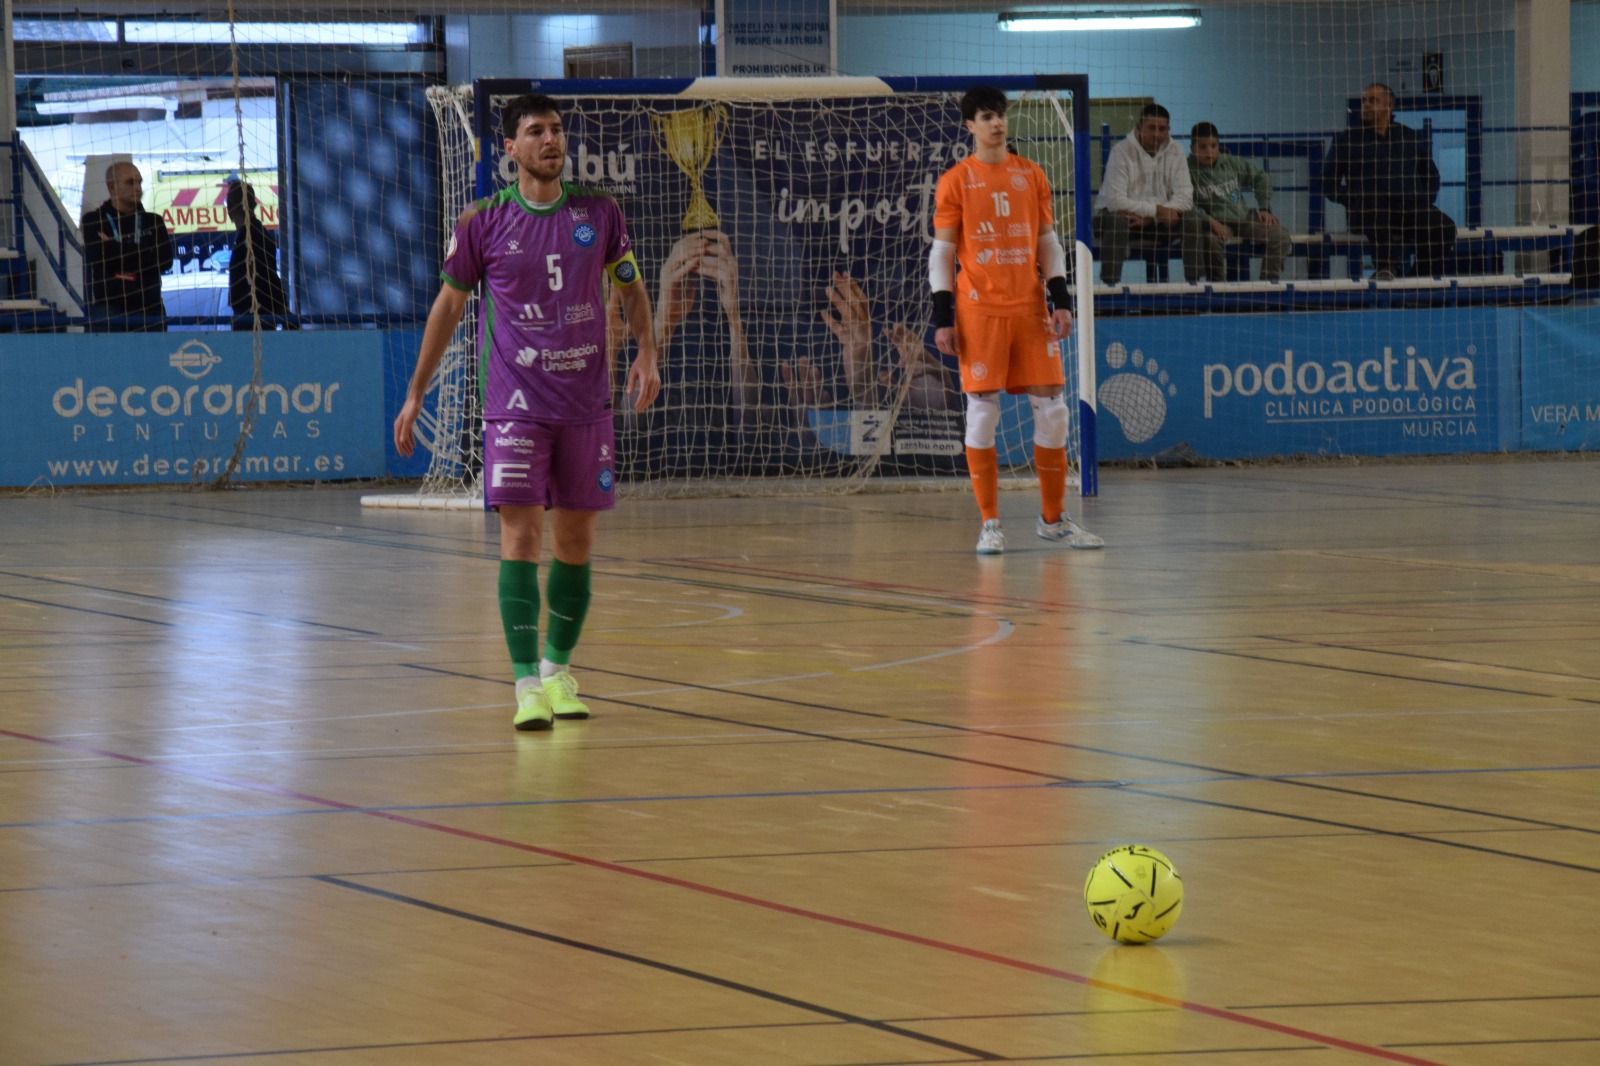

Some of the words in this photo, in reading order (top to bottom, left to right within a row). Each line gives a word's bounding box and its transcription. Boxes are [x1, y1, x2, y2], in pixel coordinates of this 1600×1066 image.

[732, 64, 810, 74] PROHIBICIONES
[813, 64, 827, 73] DE
[755, 140, 787, 161] EL
[805, 140, 968, 161] ESFUERZO
[992, 191, 1010, 217] 16
[546, 254, 563, 291] 5
[541, 343, 598, 361] Fundación
[542, 359, 587, 372] Unicaja
[1203, 346, 1477, 419] podoactiva
[52, 377, 340, 418] decoramar
[1265, 397, 1344, 417] CLÍNICA
[1352, 393, 1477, 414] PODOLÓGICA
[1530, 405, 1580, 423] VERA
[73, 420, 321, 442] PINTURAS
[1402, 420, 1478, 438] MURCIA
[494, 436, 535, 448] Halcón
[48, 453, 345, 478] www.decoramar.es
